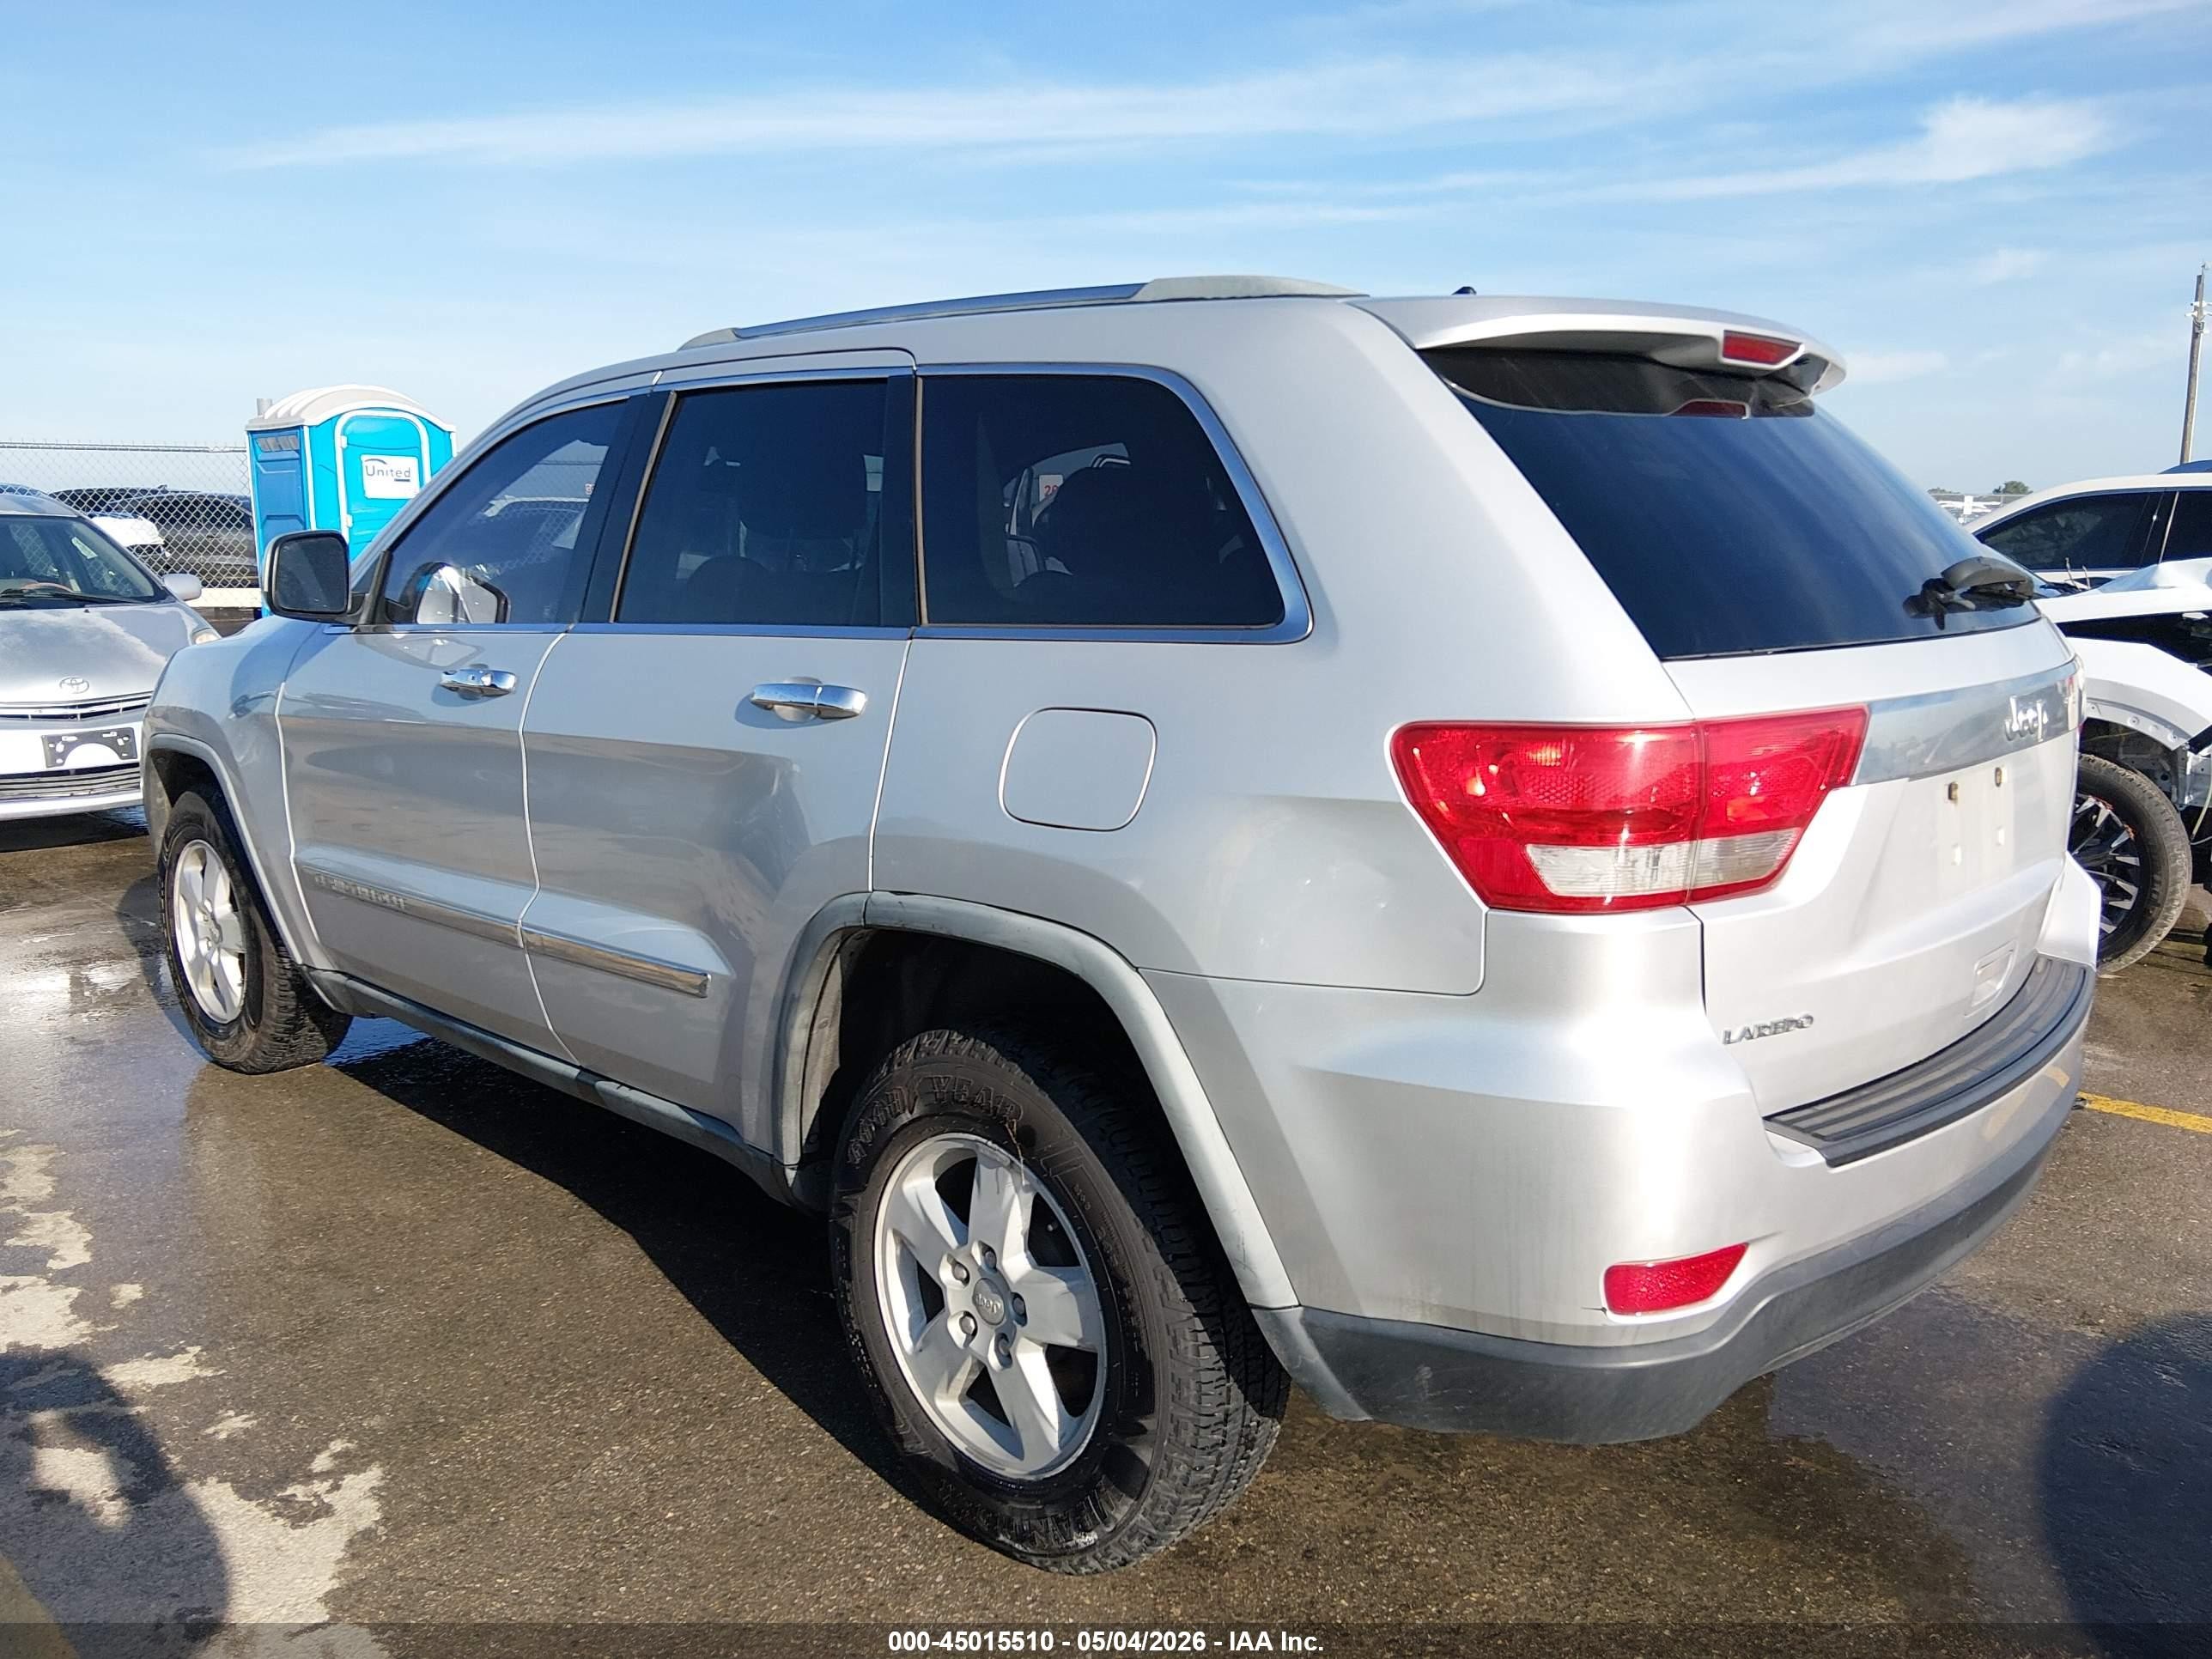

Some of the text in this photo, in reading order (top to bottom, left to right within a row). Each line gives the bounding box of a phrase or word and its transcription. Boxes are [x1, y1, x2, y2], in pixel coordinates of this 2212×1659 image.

[365, 465, 411, 478] United
[2004, 696, 2049, 743] Jeep
[1722, 1013, 1814, 1045] LAREDO
